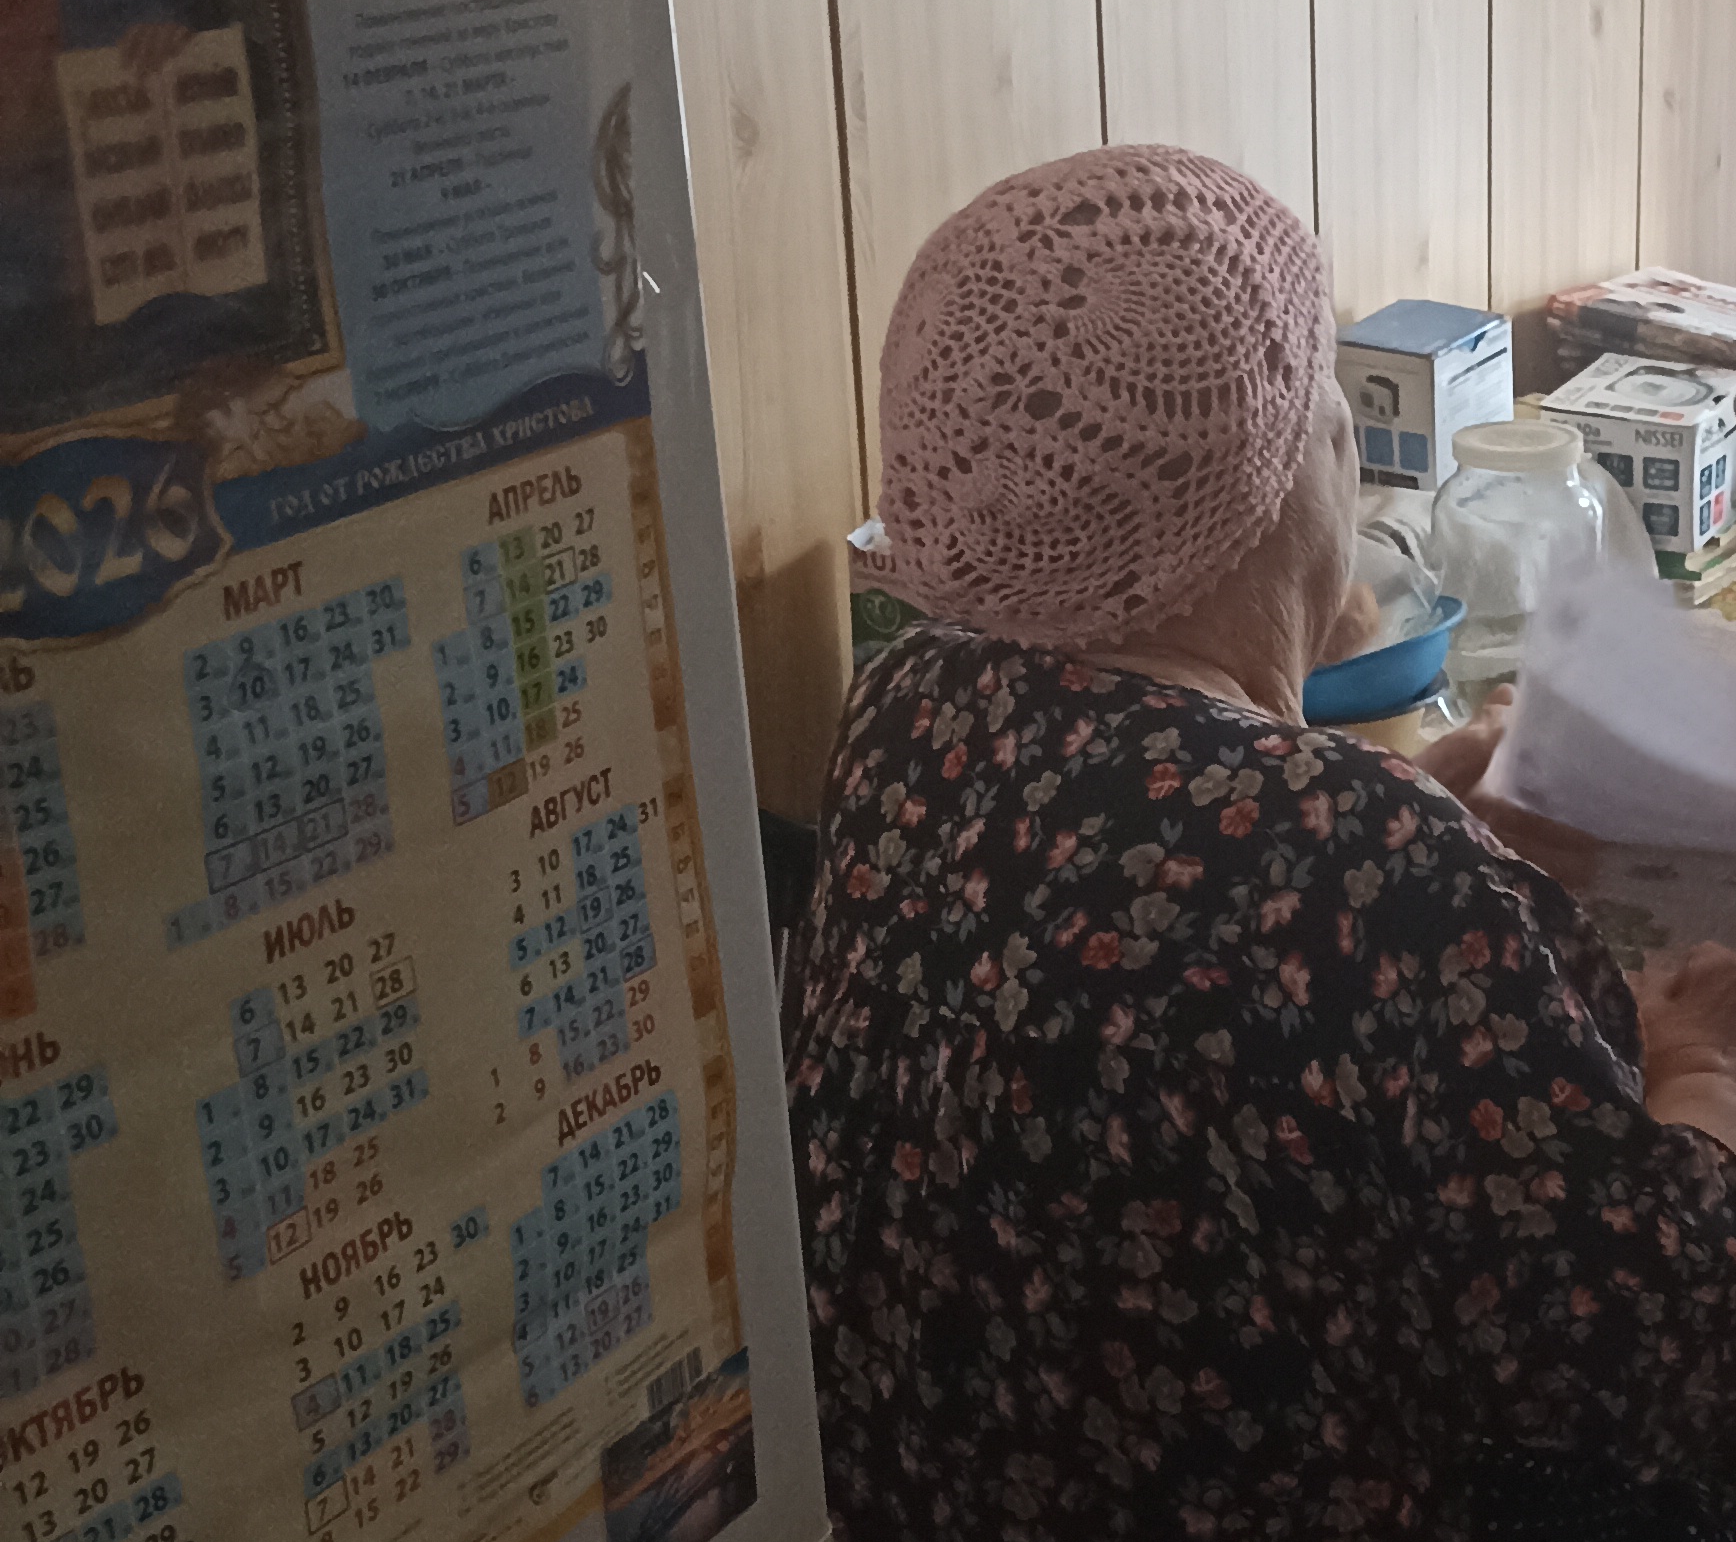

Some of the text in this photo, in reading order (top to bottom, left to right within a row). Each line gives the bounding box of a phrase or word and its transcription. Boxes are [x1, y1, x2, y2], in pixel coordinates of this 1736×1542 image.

[269, 489, 315, 523] ГОД
[318, 476, 349, 506] ОТ
[492, 396, 594, 450] ХРИСТОВА
[1634, 427, 1685, 449] NISSEI
[488, 466, 582, 525] АПРЕЛЬ
[468, 508, 594, 575] 6 13 20 27
[194, 584, 393, 682] 2 9 16 23 30
[223, 561, 303, 621] МАРТ
[438, 580, 604, 665] 1 8 15 22 29
[199, 625, 395, 722] 3 10 17 24 31
[445, 615, 608, 706] 2 9 16 23 30
[449, 665, 578, 743] 3 10 17 24
[7, 756, 42, 788] 24
[212, 718, 370, 803] 5 12 19 26
[215, 754, 373, 839] 6 13 20 27
[13, 797, 49, 831] 25
[510, 797, 658, 893] 3 10 17 24 31
[529, 767, 612, 839] АВГУСТ
[24, 840, 59, 875] 26
[31, 881, 63, 916] 27
[263, 898, 356, 964] ИЮЛЬ
[516, 879, 635, 961] 5 12 19 26
[520, 913, 640, 996] 6 13 20 27
[240, 932, 395, 1025] 6 13 20 27
[525, 945, 646, 1030] 7 14 21 28
[7, 1074, 94, 1134] 22 29
[201, 1004, 407, 1125] 1 8 15 22 29
[207, 1042, 412, 1167] 2 9 16 23 30
[557, 1059, 661, 1147] ДЕКАБРЬ
[13, 1114, 103, 1176] 23 30
[215, 1077, 416, 1205] 3 10 17 24 31
[548, 1098, 669, 1188] 7 14 21 28
[21, 1178, 57, 1215] 24
[26, 1218, 62, 1257] 25
[34, 1260, 70, 1297] 26
[291, 1216, 479, 1347] 2 9 16 23 30
[300, 1210, 413, 1300] НОЯБРЬ
[296, 1275, 445, 1383] 3 10 17 24
[312, 1344, 452, 1454] 5 12 19 26
[14, 1409, 150, 1506] 12 19 26
[75, 1478, 108, 1515] 20
[125, 1447, 155, 1485] 27
[134, 1486, 168, 1523] 28
